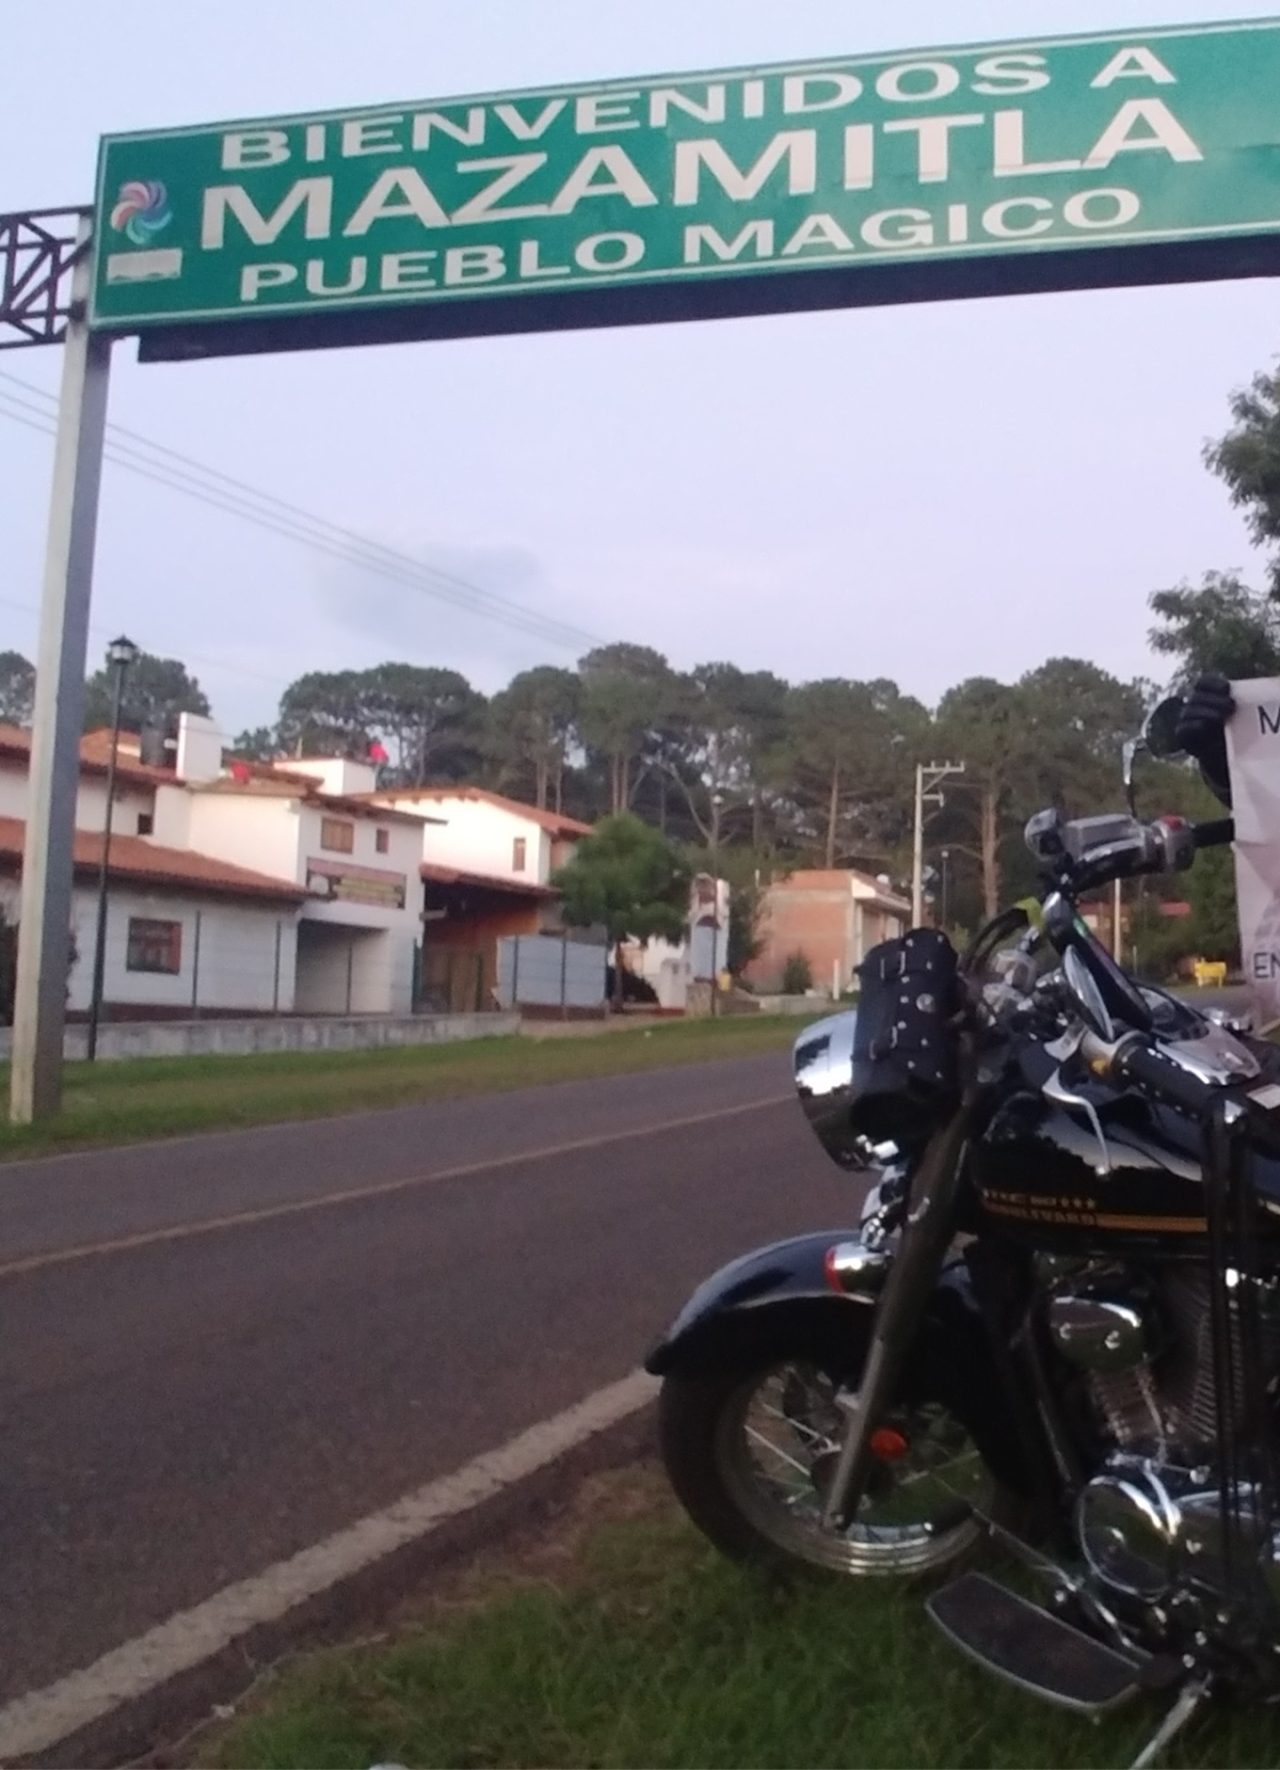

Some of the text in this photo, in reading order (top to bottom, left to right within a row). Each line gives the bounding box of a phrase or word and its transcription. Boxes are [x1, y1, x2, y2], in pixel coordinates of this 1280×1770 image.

[221, 46, 1177, 171] BIENVENIDOS A
[201, 97, 1205, 250] MAZAMITLA
[240, 188, 1142, 301] PUEBLO MAGICO
